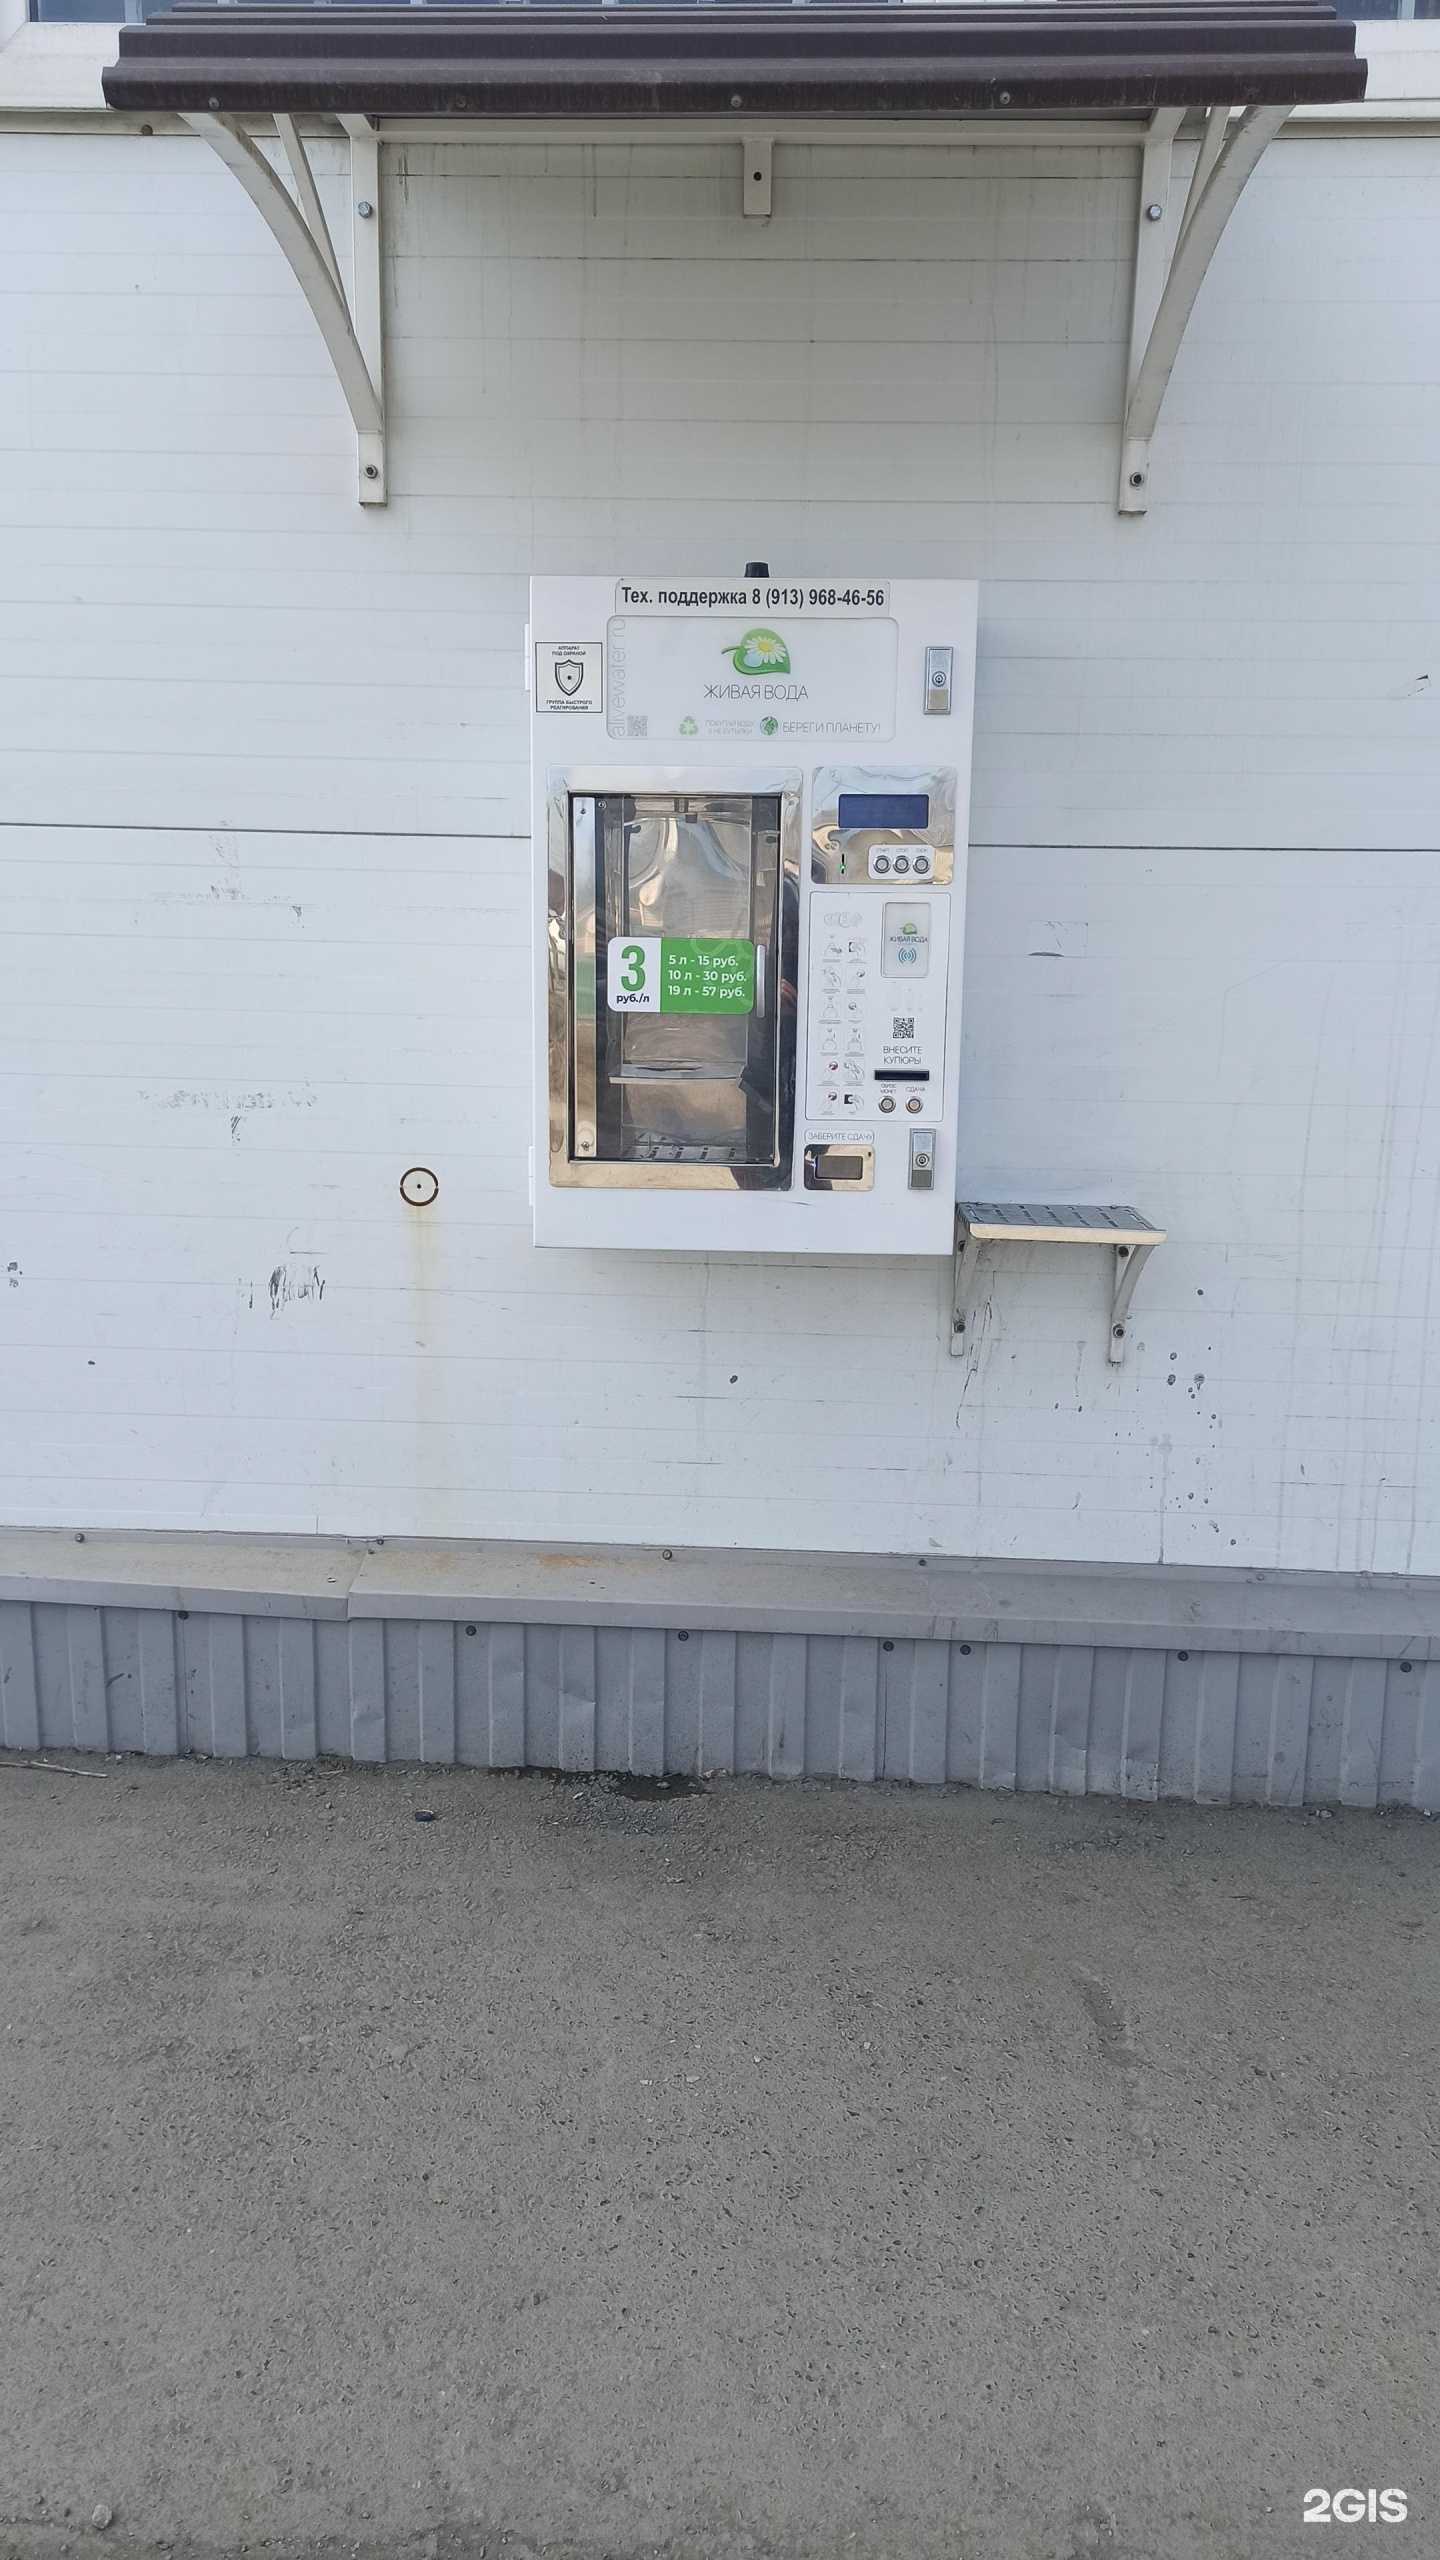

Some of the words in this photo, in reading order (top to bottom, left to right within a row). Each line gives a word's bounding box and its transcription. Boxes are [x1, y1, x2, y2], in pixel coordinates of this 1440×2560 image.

[621, 587, 653, 604] Тех.
[658, 590, 747, 608] поддержка
[752, 588, 761, 605] 8
[766, 588, 804, 608] (913)
[809, 589, 885, 606] 968-46-56
[703, 684, 761, 700] ЖИВАЯ
[764, 684, 809, 702] ВОДА
[782, 722, 825, 734] БЕРЕГИ
[826, 722, 881, 735] ПЛАНЕТУ!
[669, 954, 677, 965] 5
[679, 957, 687, 965] л
[698, 955, 710, 965] 15
[713, 955, 739, 968] руб.
[621, 945, 646, 992] 3
[668, 970, 681, 980] 10
[684, 972, 692, 980] л
[703, 971, 718, 981] 30
[721, 971, 747, 983] руб.
[668, 985, 681, 996] 19
[683, 987, 691, 996] л
[702, 986, 716, 997] 57
[720, 986, 745, 998] руб.
[616, 993, 650, 1004] руб./л
[883, 1046, 922, 1054] ВНЕСИТЕ
[883, 1056, 921, 1065] КУПЮРЫ
[808, 1132, 846, 1140] ЗАБЕРИТЕ
[847, 1132, 872, 1141] СДАЧУ
